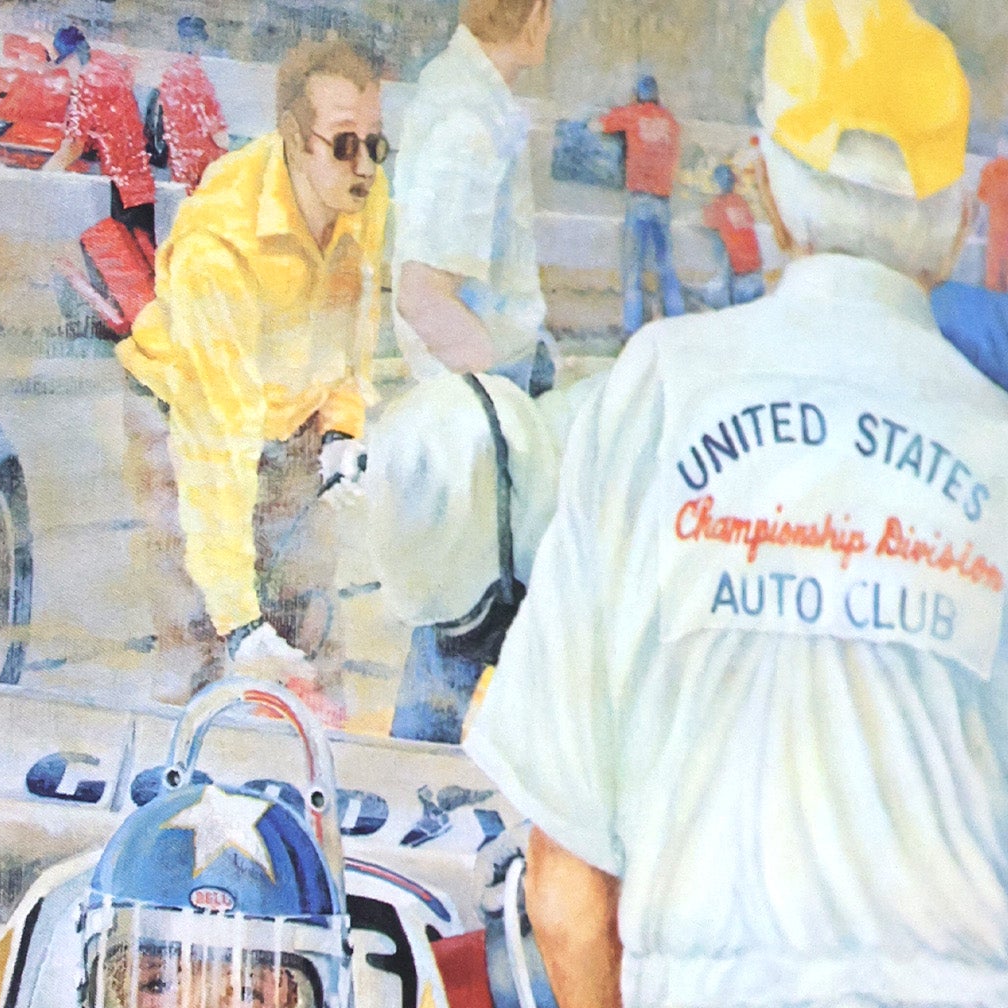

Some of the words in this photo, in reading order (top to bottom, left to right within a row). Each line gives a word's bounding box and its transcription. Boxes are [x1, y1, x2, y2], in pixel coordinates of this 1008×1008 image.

[677, 402, 827, 491] UNITED
[855, 412, 990, 522] STATES
[674, 494, 868, 571] Championship
[875, 516, 1004, 593] Division
[711, 571, 823, 624] AUTO
[845, 579, 958, 641] CLUB
[195, 891, 232, 910] BELL
